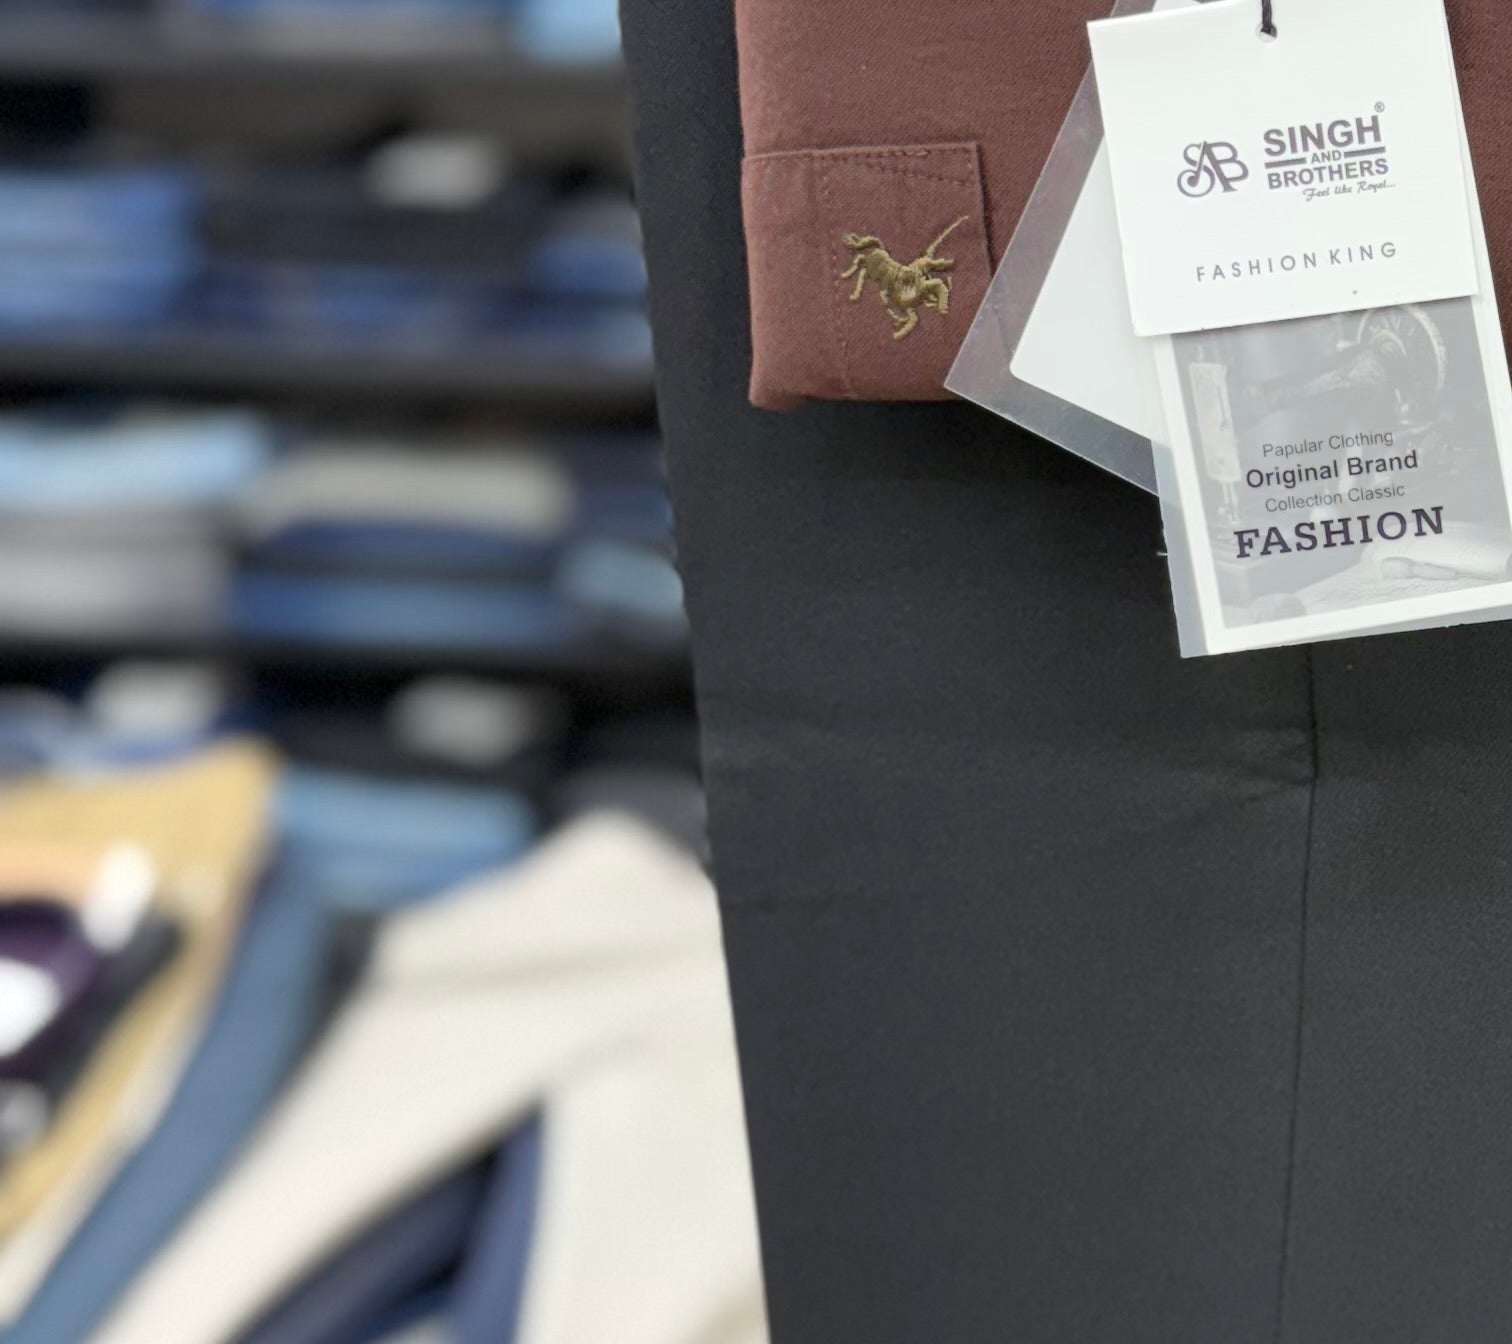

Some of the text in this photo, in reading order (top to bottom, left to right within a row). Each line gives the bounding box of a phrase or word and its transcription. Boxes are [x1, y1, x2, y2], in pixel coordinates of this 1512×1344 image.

[1263, 115, 1382, 157] SINGH
[1311, 150, 1342, 164] AND
[1267, 158, 1389, 190] BROTHERS
[1302, 187, 1330, 202] Feel
[1334, 184, 1353, 195] like
[1196, 242, 1396, 282] FASHION KING
[1262, 431, 1394, 458] Papular Clothing
[1246, 450, 1418, 489] Original Brand
[1265, 484, 1406, 512] Collection Classic
[1233, 506, 1444, 558] FASHION
